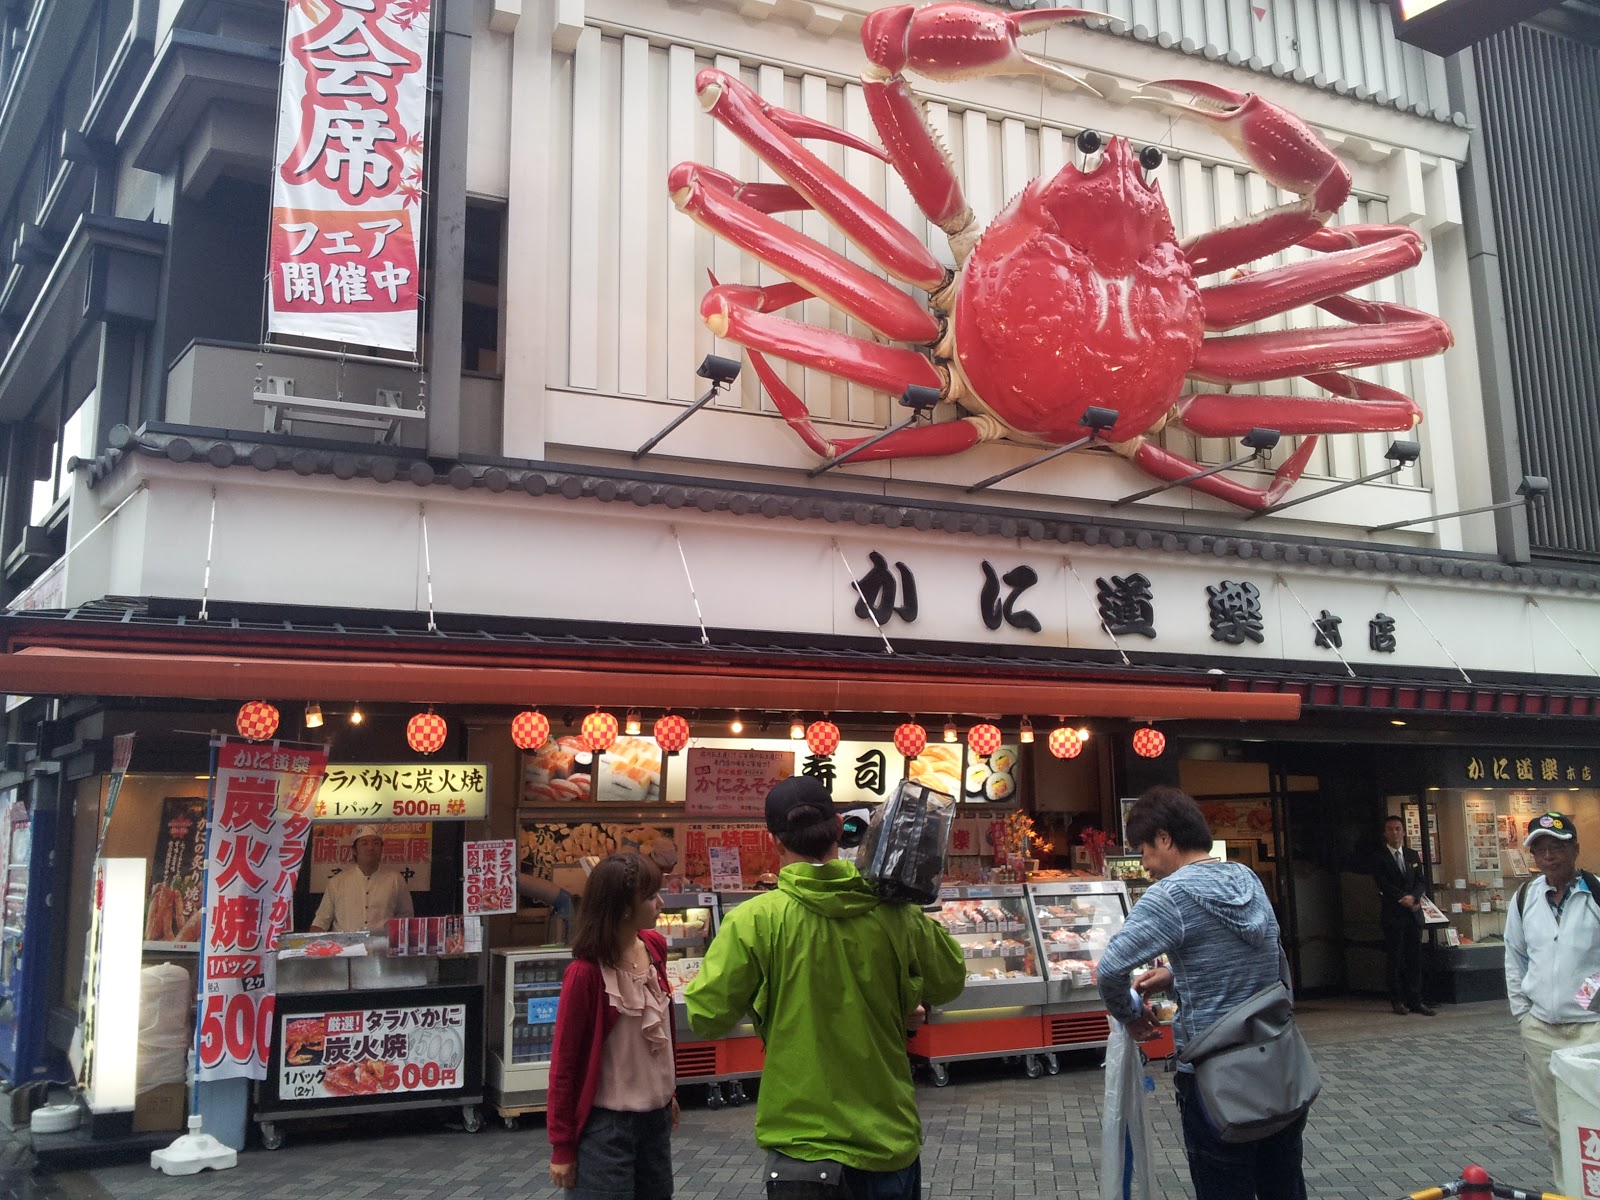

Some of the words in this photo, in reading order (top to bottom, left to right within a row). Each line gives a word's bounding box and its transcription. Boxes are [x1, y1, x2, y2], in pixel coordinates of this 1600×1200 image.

[294, 0, 411, 195] 会席
[279, 218, 403, 258] フェア
[279, 261, 411, 305] 開催中
[1313, 608, 1397, 654] 本店
[802, 749, 887, 796] 寿司
[1566, 766, 1592, 782] 本店
[334, 801, 383, 816] 1パック
[392, 800, 441, 817] 500円
[211, 776, 280, 950] 炭火焼
[481, 848, 497, 890] 炭火焼
[499, 847, 514, 910] タラバかに
[467, 874, 481, 913] 500円
[209, 958, 257, 977] 1パック
[327, 1016, 361, 1032] 厳選!
[365, 1007, 462, 1032] タラバかに
[324, 1034, 408, 1063] 炭火焼
[284, 1070, 326, 1086] 1パック
[380, 1062, 457, 1091] 500円
